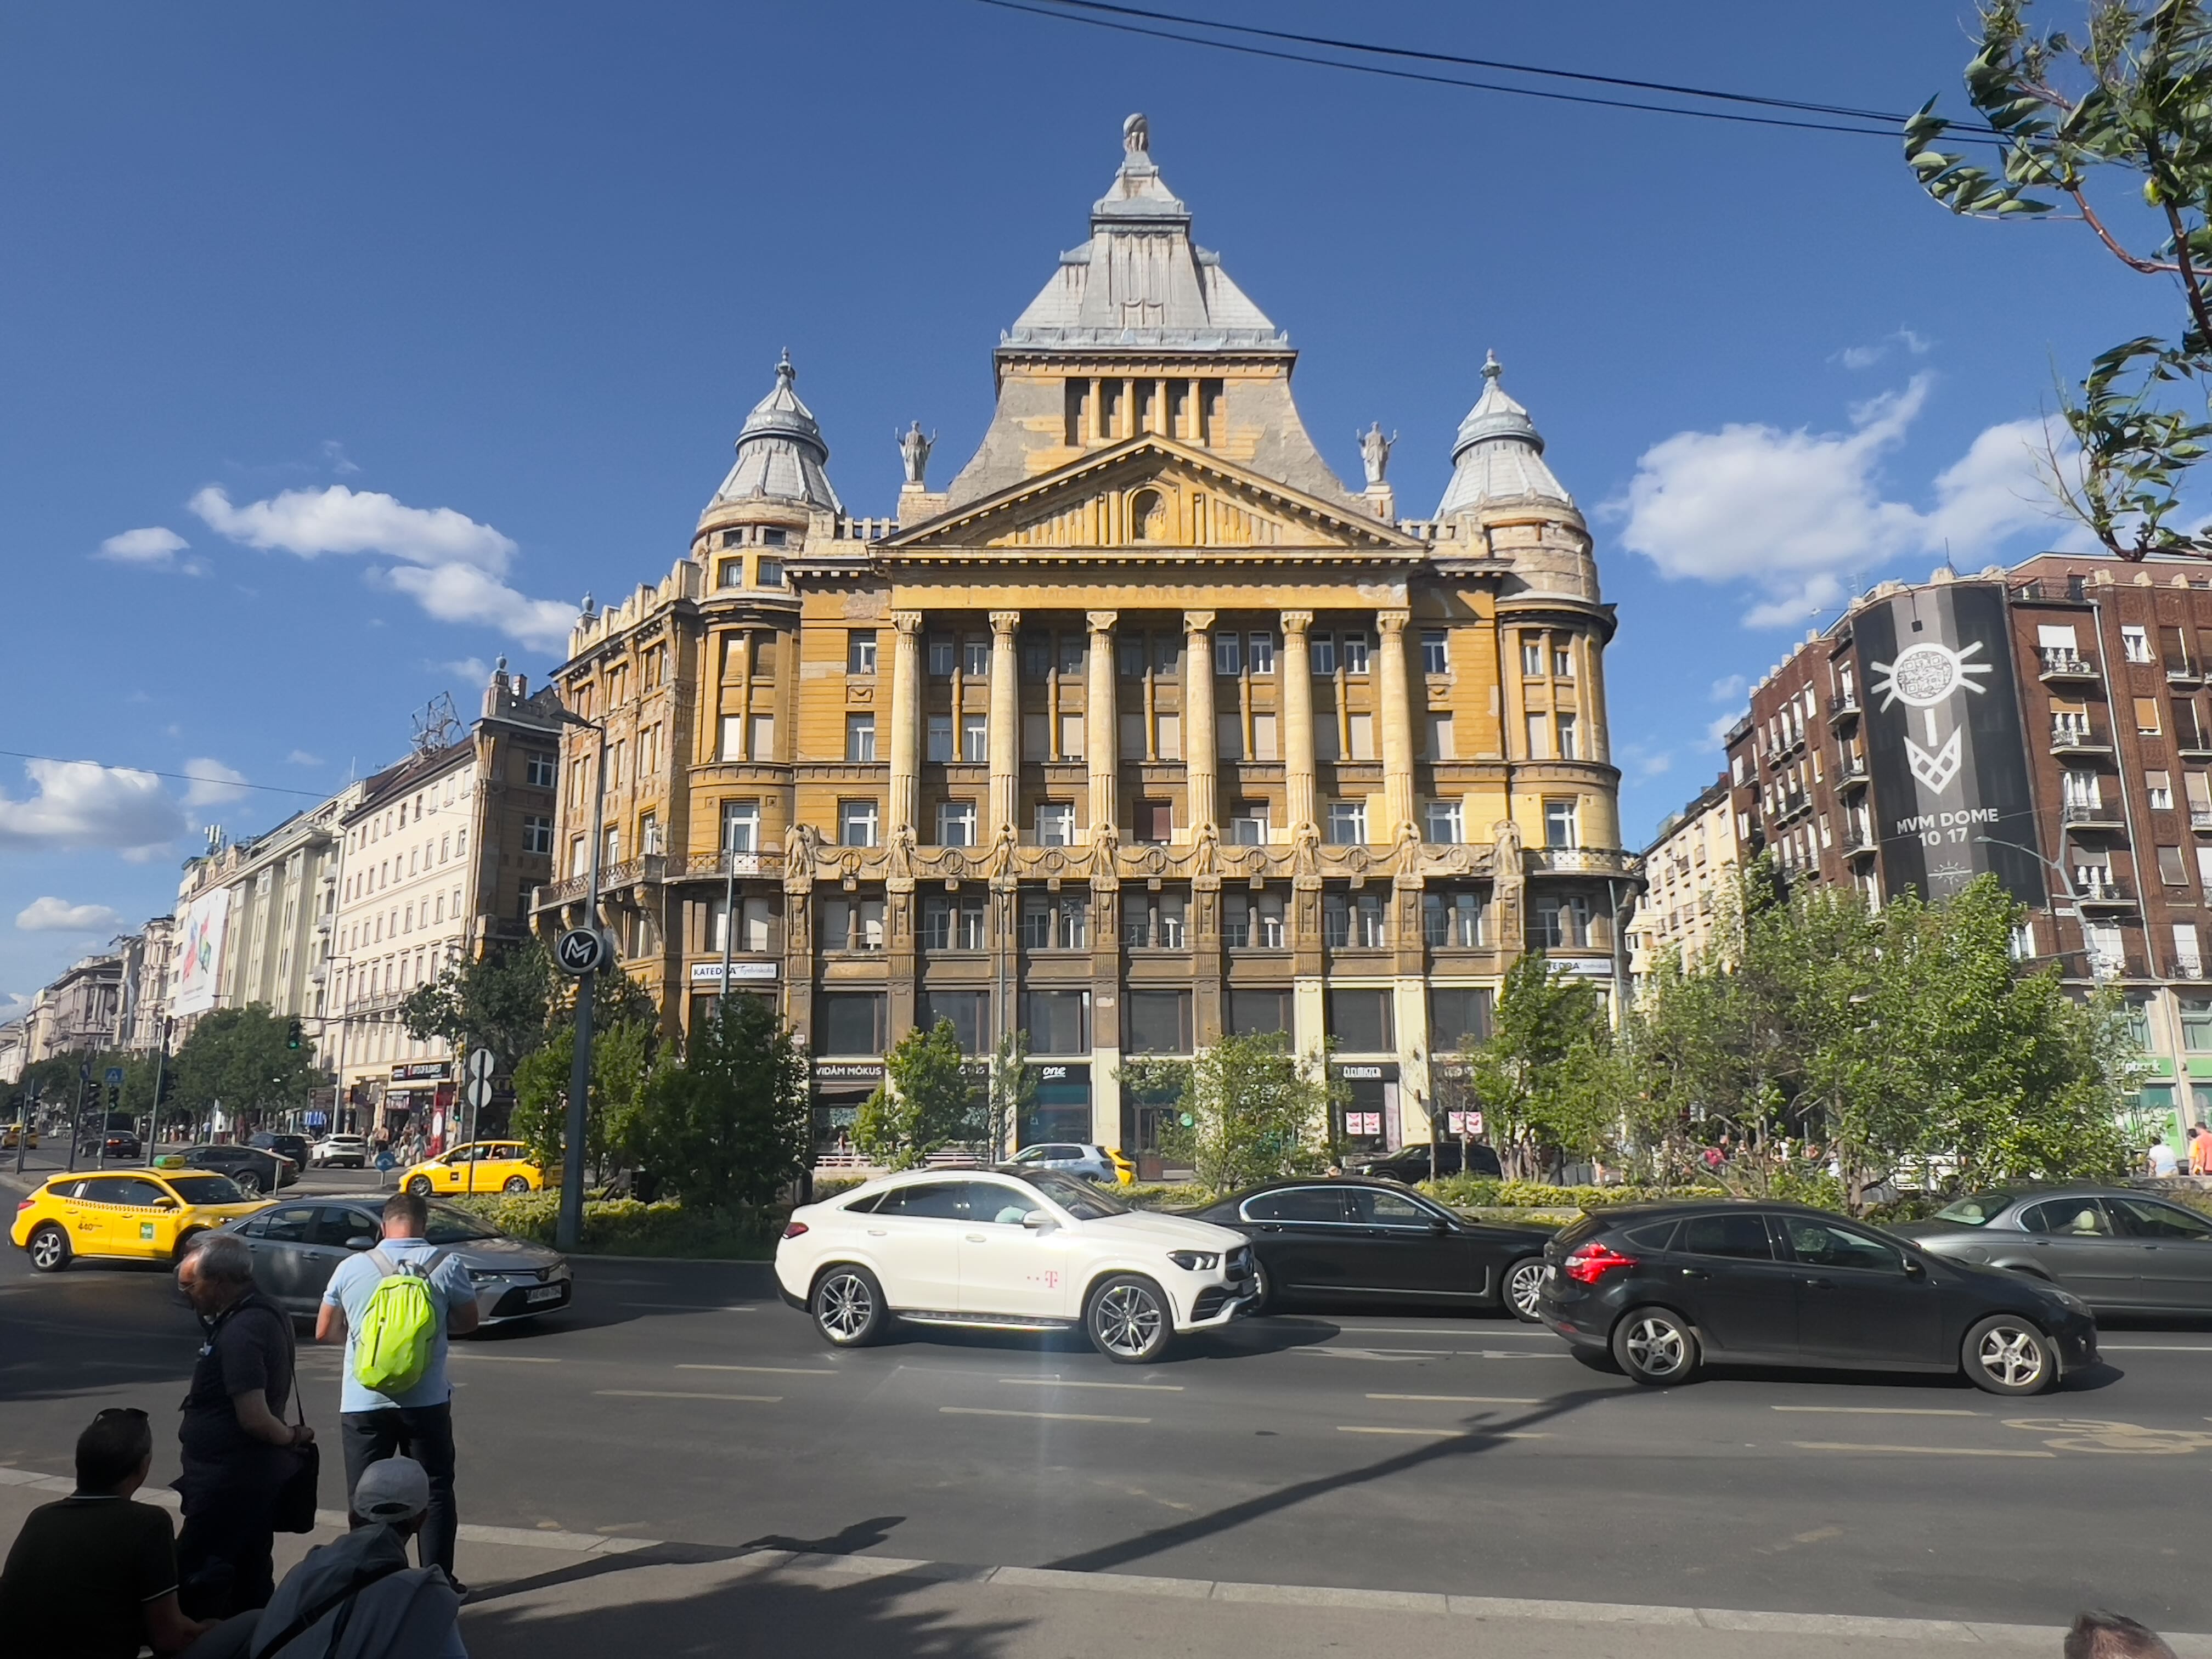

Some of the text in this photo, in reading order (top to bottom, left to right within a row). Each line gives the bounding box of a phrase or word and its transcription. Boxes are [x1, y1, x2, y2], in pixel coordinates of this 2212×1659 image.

[1897, 808, 1999, 834] MVM DOME
[1918, 827, 1968, 847] 10 17
[694, 967, 736, 975] KATEDA
[816, 1065, 882, 1075] VIDÁM MÓKUS
[1042, 1066, 1066, 1076] one
